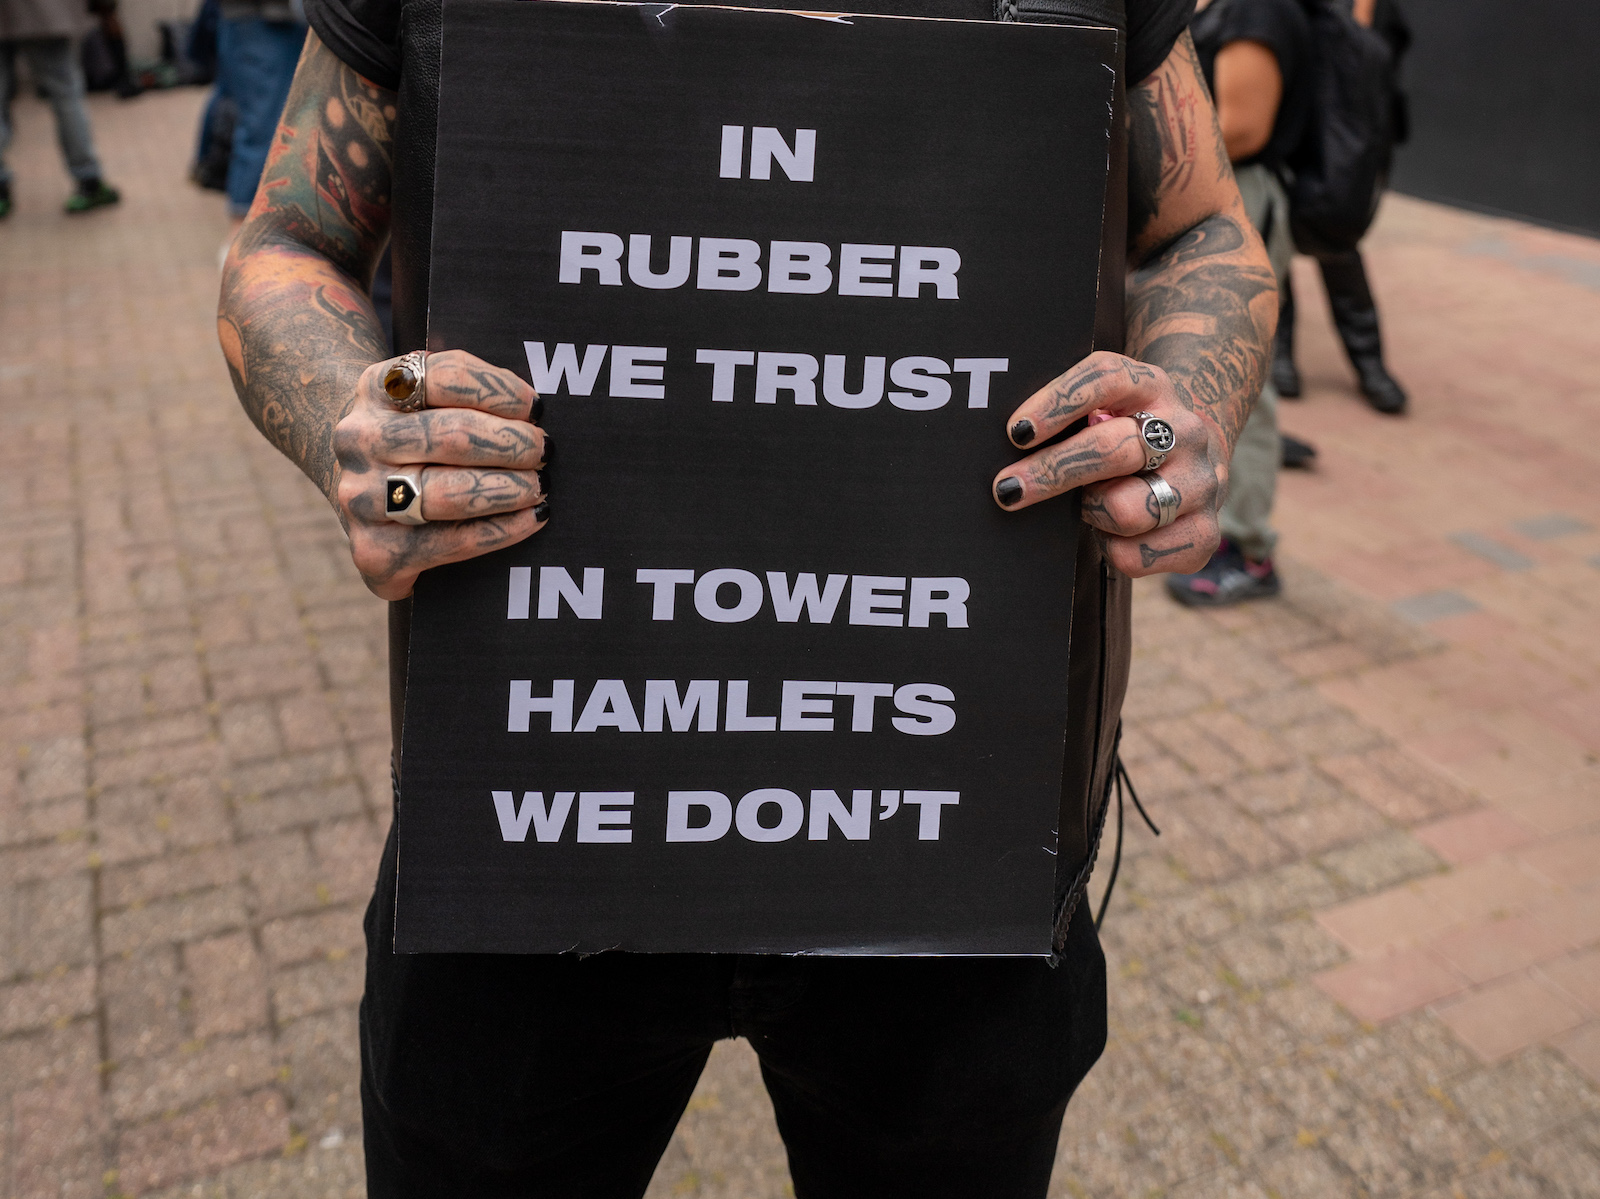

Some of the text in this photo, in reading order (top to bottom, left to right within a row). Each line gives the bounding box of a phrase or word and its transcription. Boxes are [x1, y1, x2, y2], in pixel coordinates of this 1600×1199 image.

[719, 124, 817, 182] IN
[558, 230, 961, 300] RUBBER
[522, 340, 1010, 411] WE TRUST
[507, 566, 970, 628] IN TOWER
[507, 679, 956, 736] HAMLETS
[491, 788, 960, 843] WE DON’T
